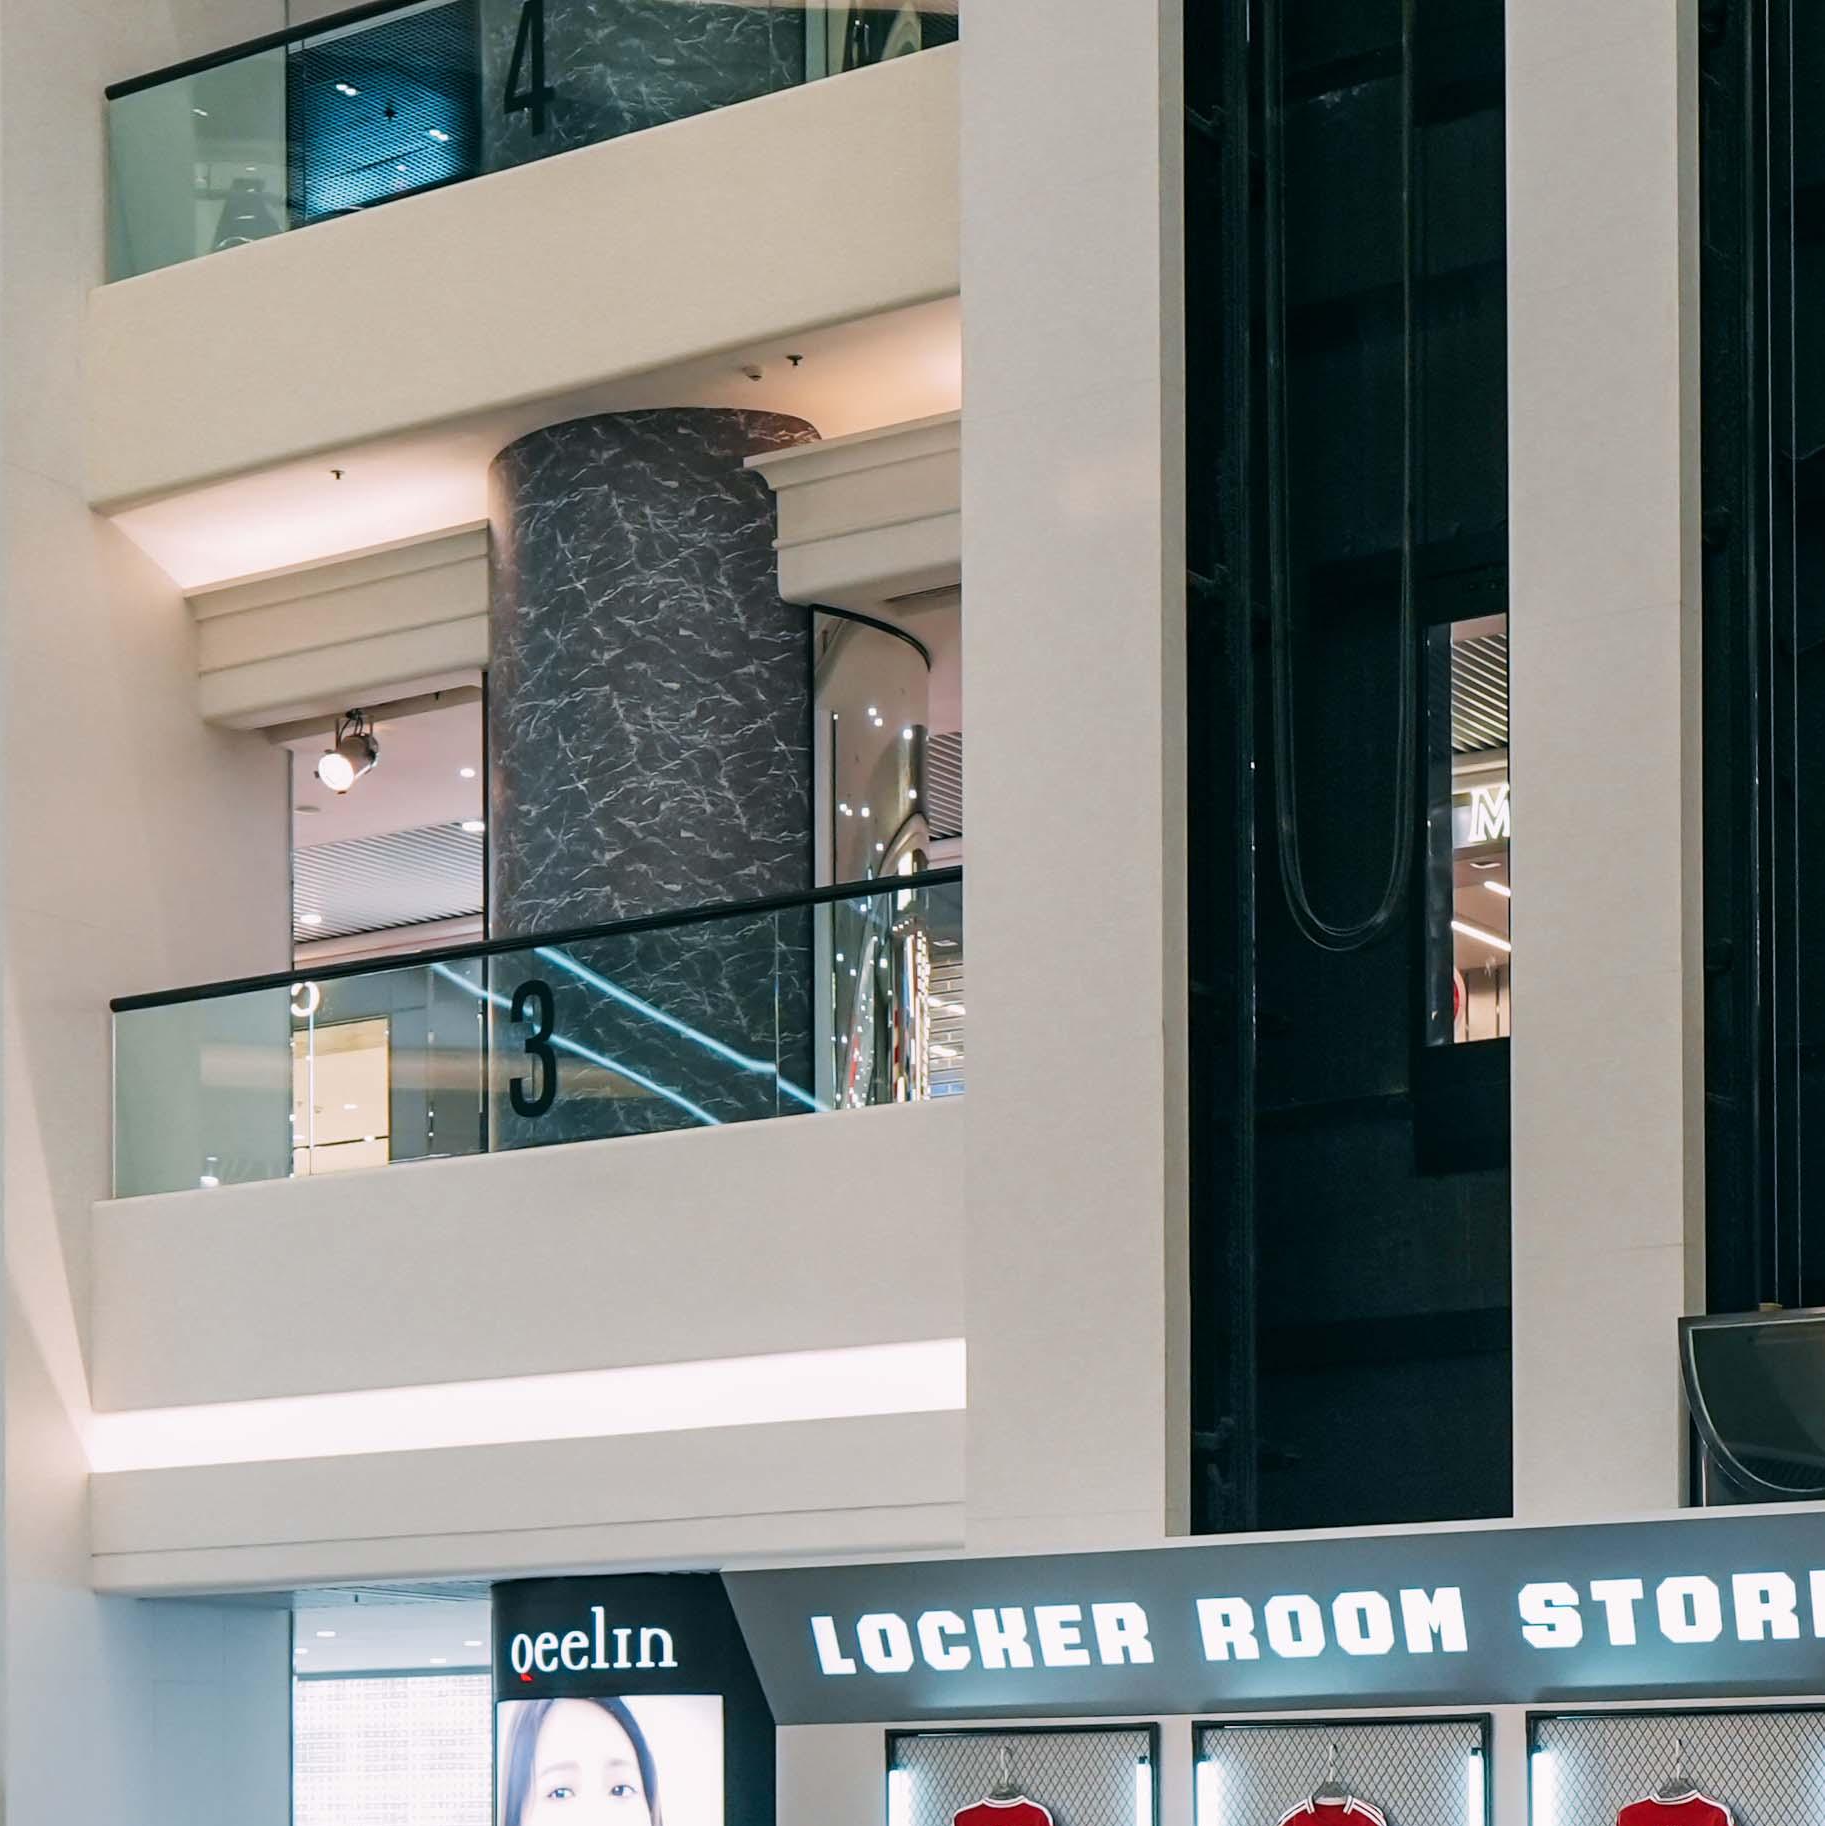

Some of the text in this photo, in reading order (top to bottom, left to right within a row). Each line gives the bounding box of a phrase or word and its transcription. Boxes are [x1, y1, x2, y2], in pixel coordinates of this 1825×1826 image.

[503, 0, 555, 137] 4
[508, 978, 558, 1118] 3
[809, 1601, 1155, 1676] LOCKER
[1195, 1586, 1468, 1663] ROOM
